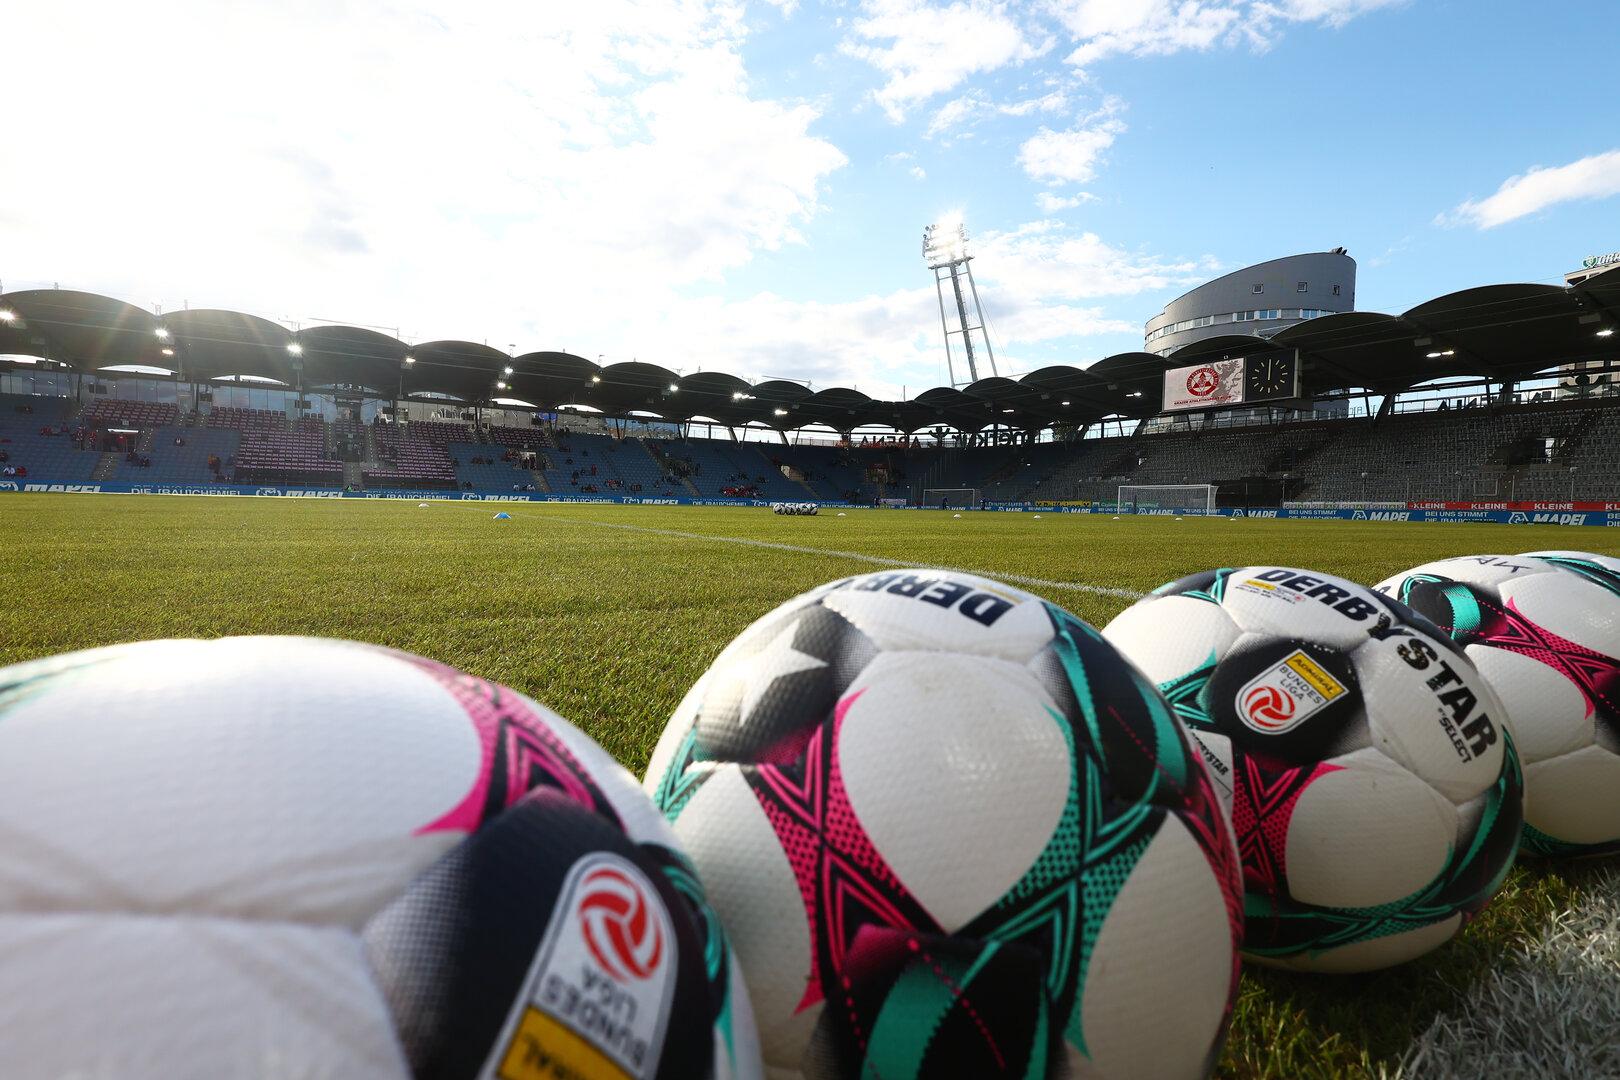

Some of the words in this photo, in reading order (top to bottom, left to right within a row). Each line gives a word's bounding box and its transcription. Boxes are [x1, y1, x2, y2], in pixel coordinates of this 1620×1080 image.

[1370, 511, 1410, 521] MAPEI
[1533, 513, 1587, 525] MAPEI
[832, 574, 1014, 627] DERB
[1280, 665, 1323, 704] BUNDES
[1280, 679, 1305, 700] LIGA
[1439, 716, 1472, 763] SELECT
